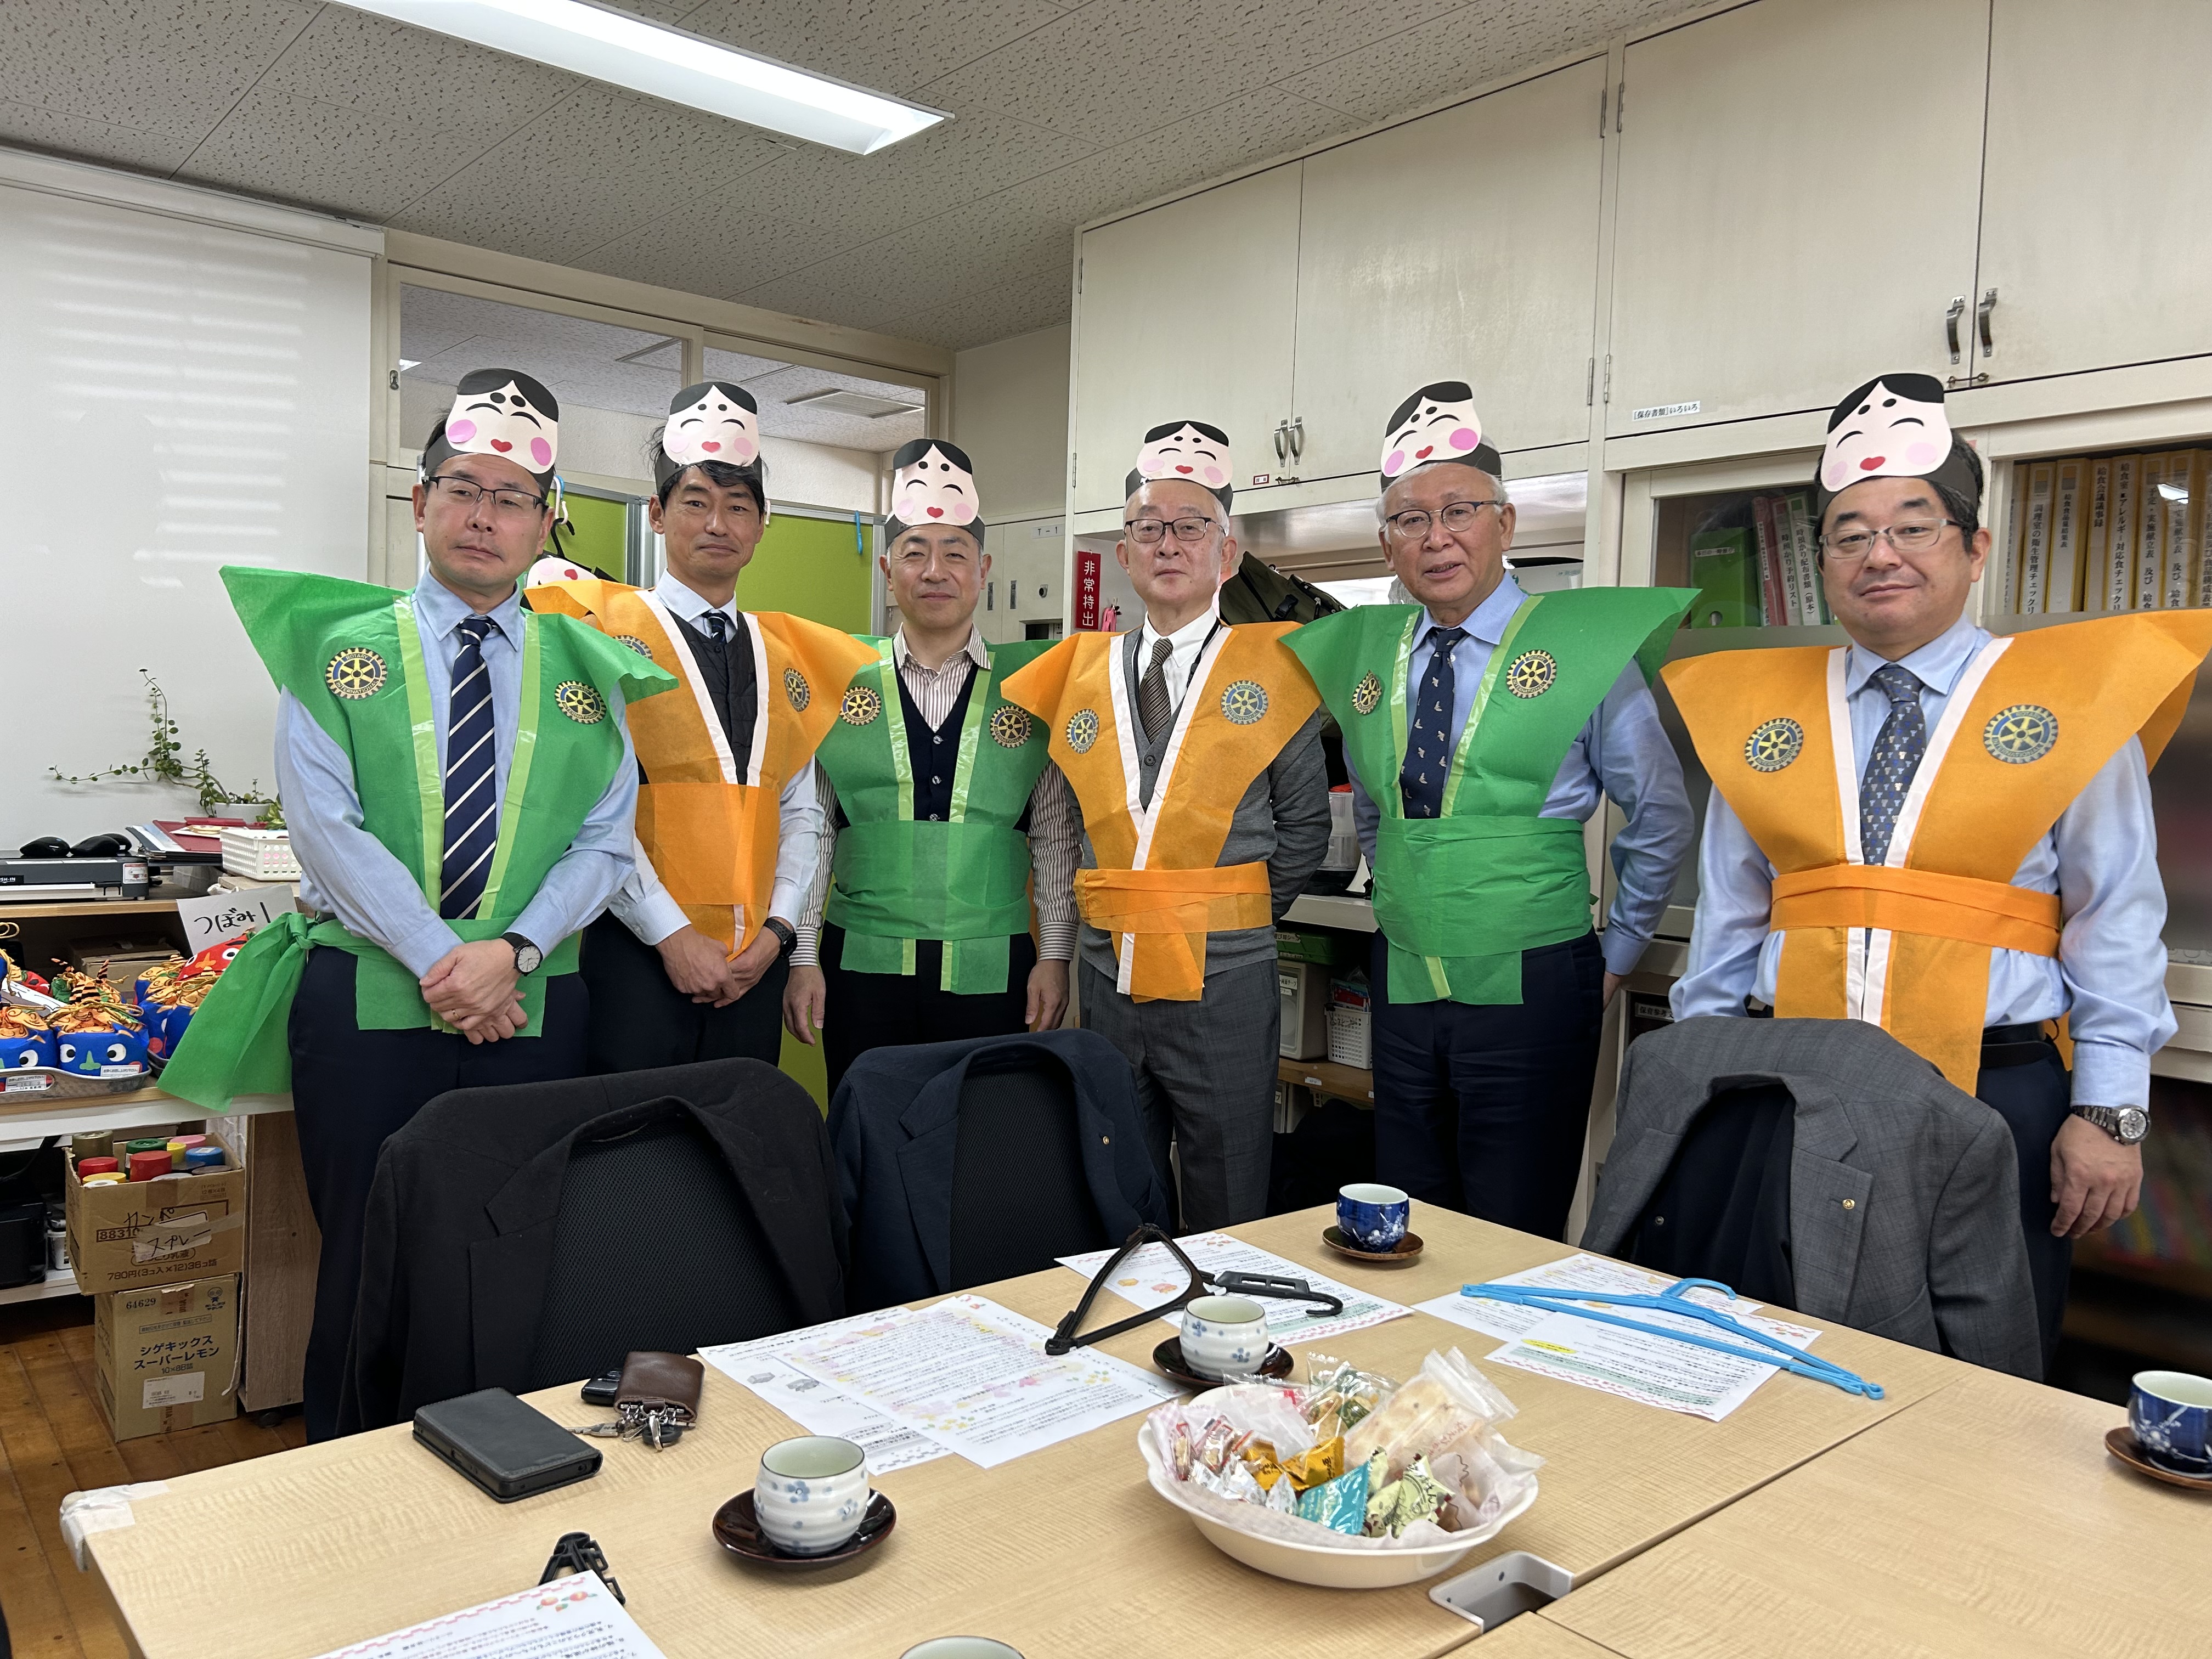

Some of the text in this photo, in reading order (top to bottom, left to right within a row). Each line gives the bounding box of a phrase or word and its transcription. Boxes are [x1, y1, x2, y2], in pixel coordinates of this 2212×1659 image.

[1082, 560, 1096, 627] 非常持出
[148, 1229, 211, 1257] スプレー
[126, 1298, 156, 1310] 64629
[140, 1335, 213, 1356] シゲキックス
[134, 1347, 219, 1370] スーパーレモン
